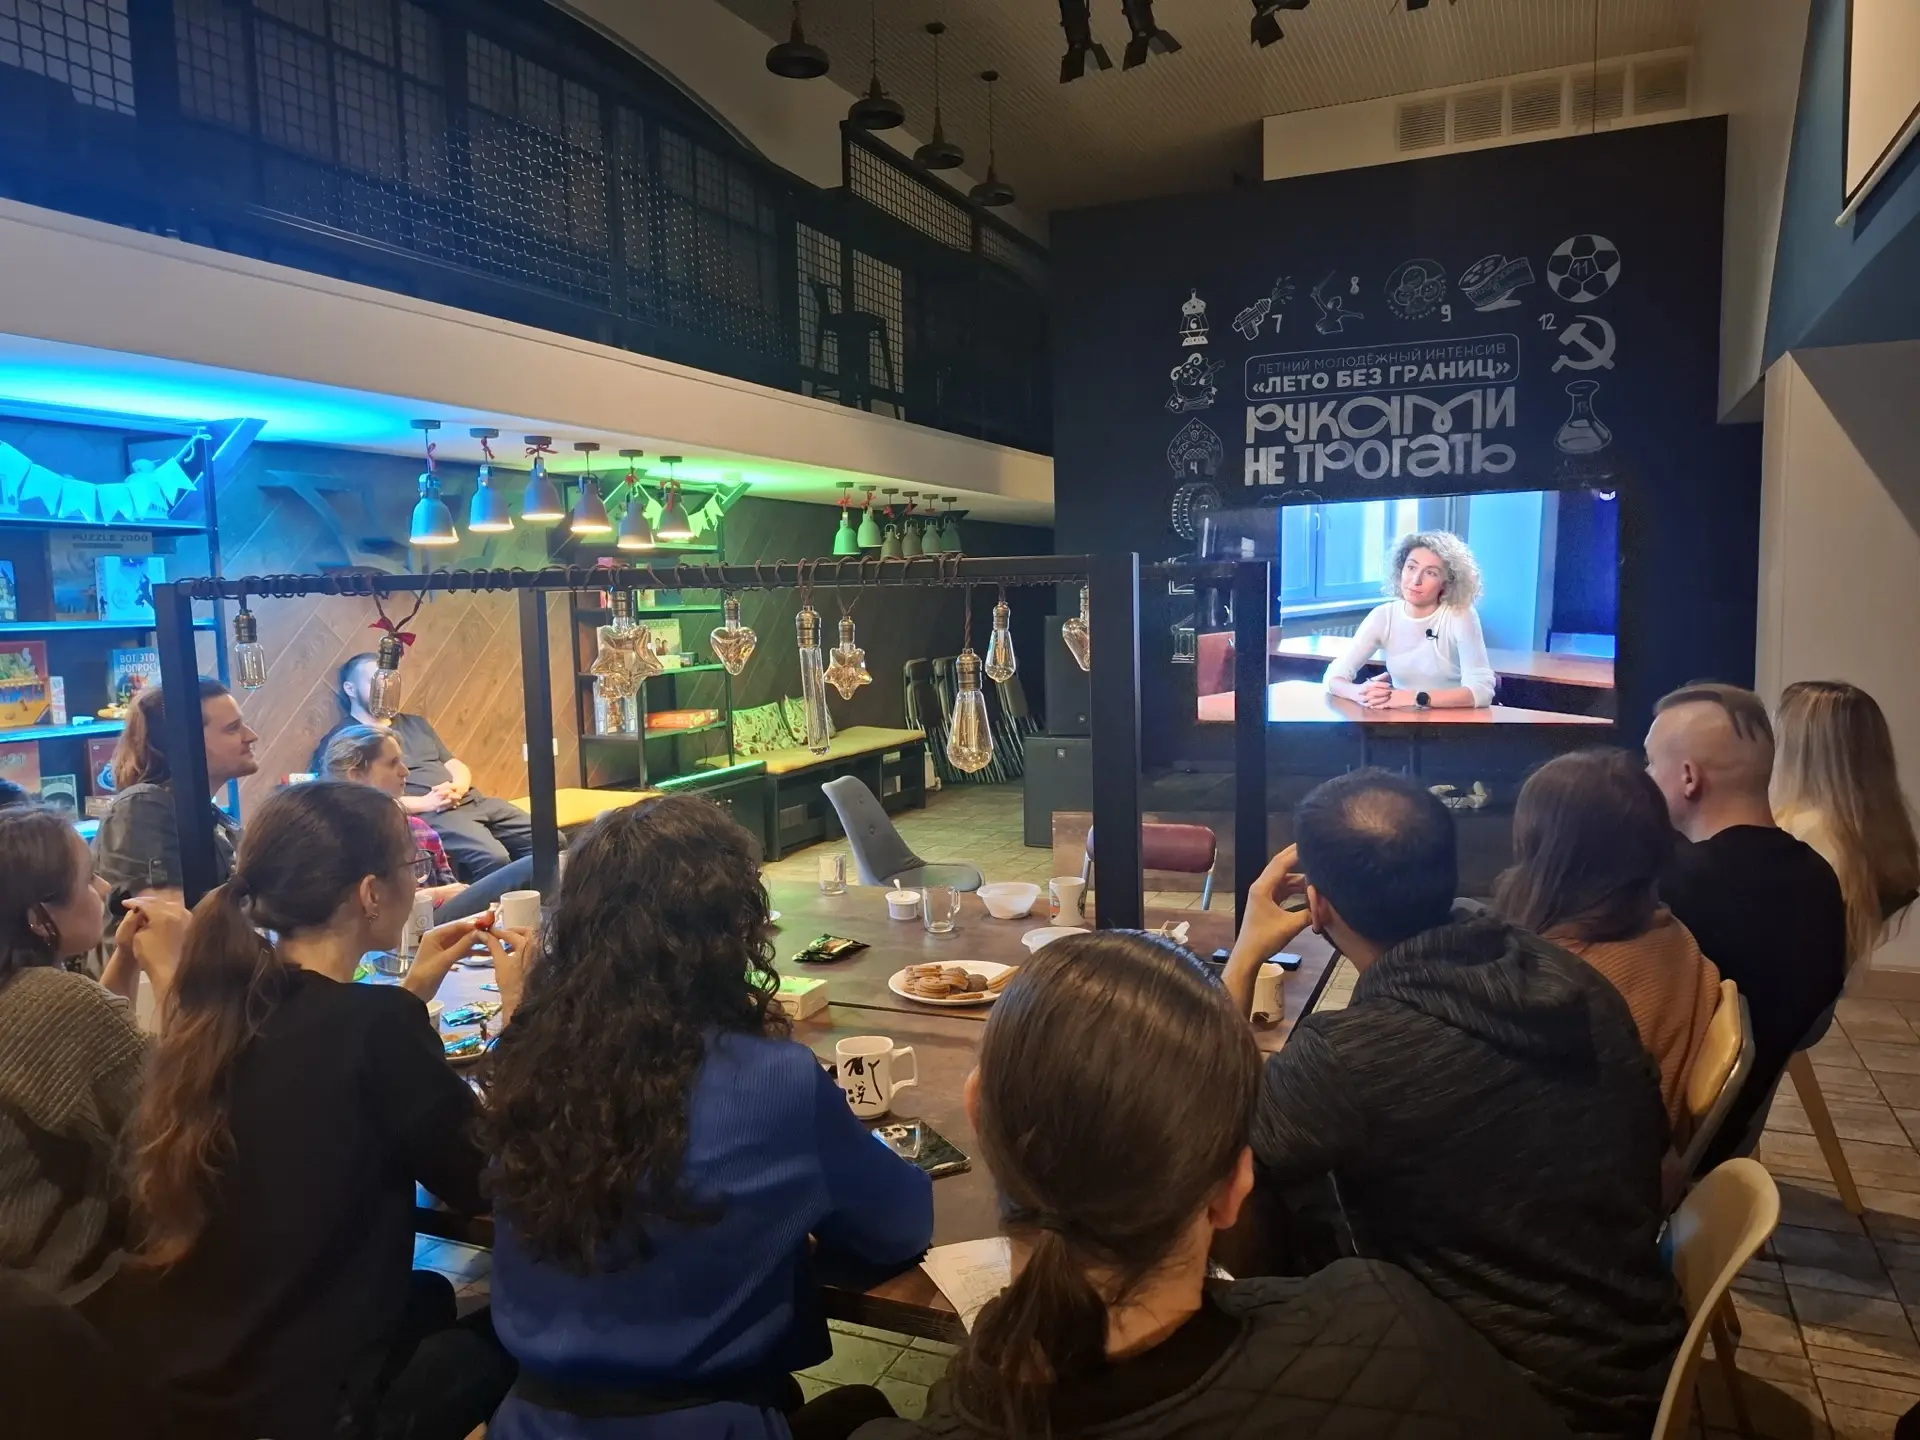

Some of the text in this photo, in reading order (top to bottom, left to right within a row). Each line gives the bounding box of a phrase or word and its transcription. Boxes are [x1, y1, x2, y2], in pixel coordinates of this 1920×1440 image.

[1350, 276, 1359, 294] 8
[1441, 304, 1451, 322] 9
[1538, 312, 1557, 330] 12
[1189, 317, 1198, 330] 6
[1271, 314, 1283, 334] 7
[1256, 343, 1506, 375] ЛЕТНИЙ МОЛОДЁЖНЫЙ ИНТЕНСИВ
[1252, 358, 1511, 394] «ЛЕТО БЕЗ ГРАНИЦ»
[1244, 445, 1286, 486] НЕ
[72, 533, 149, 542] PUZZLE 2000
[120, 652, 155, 663] ВОТ ЭТО
